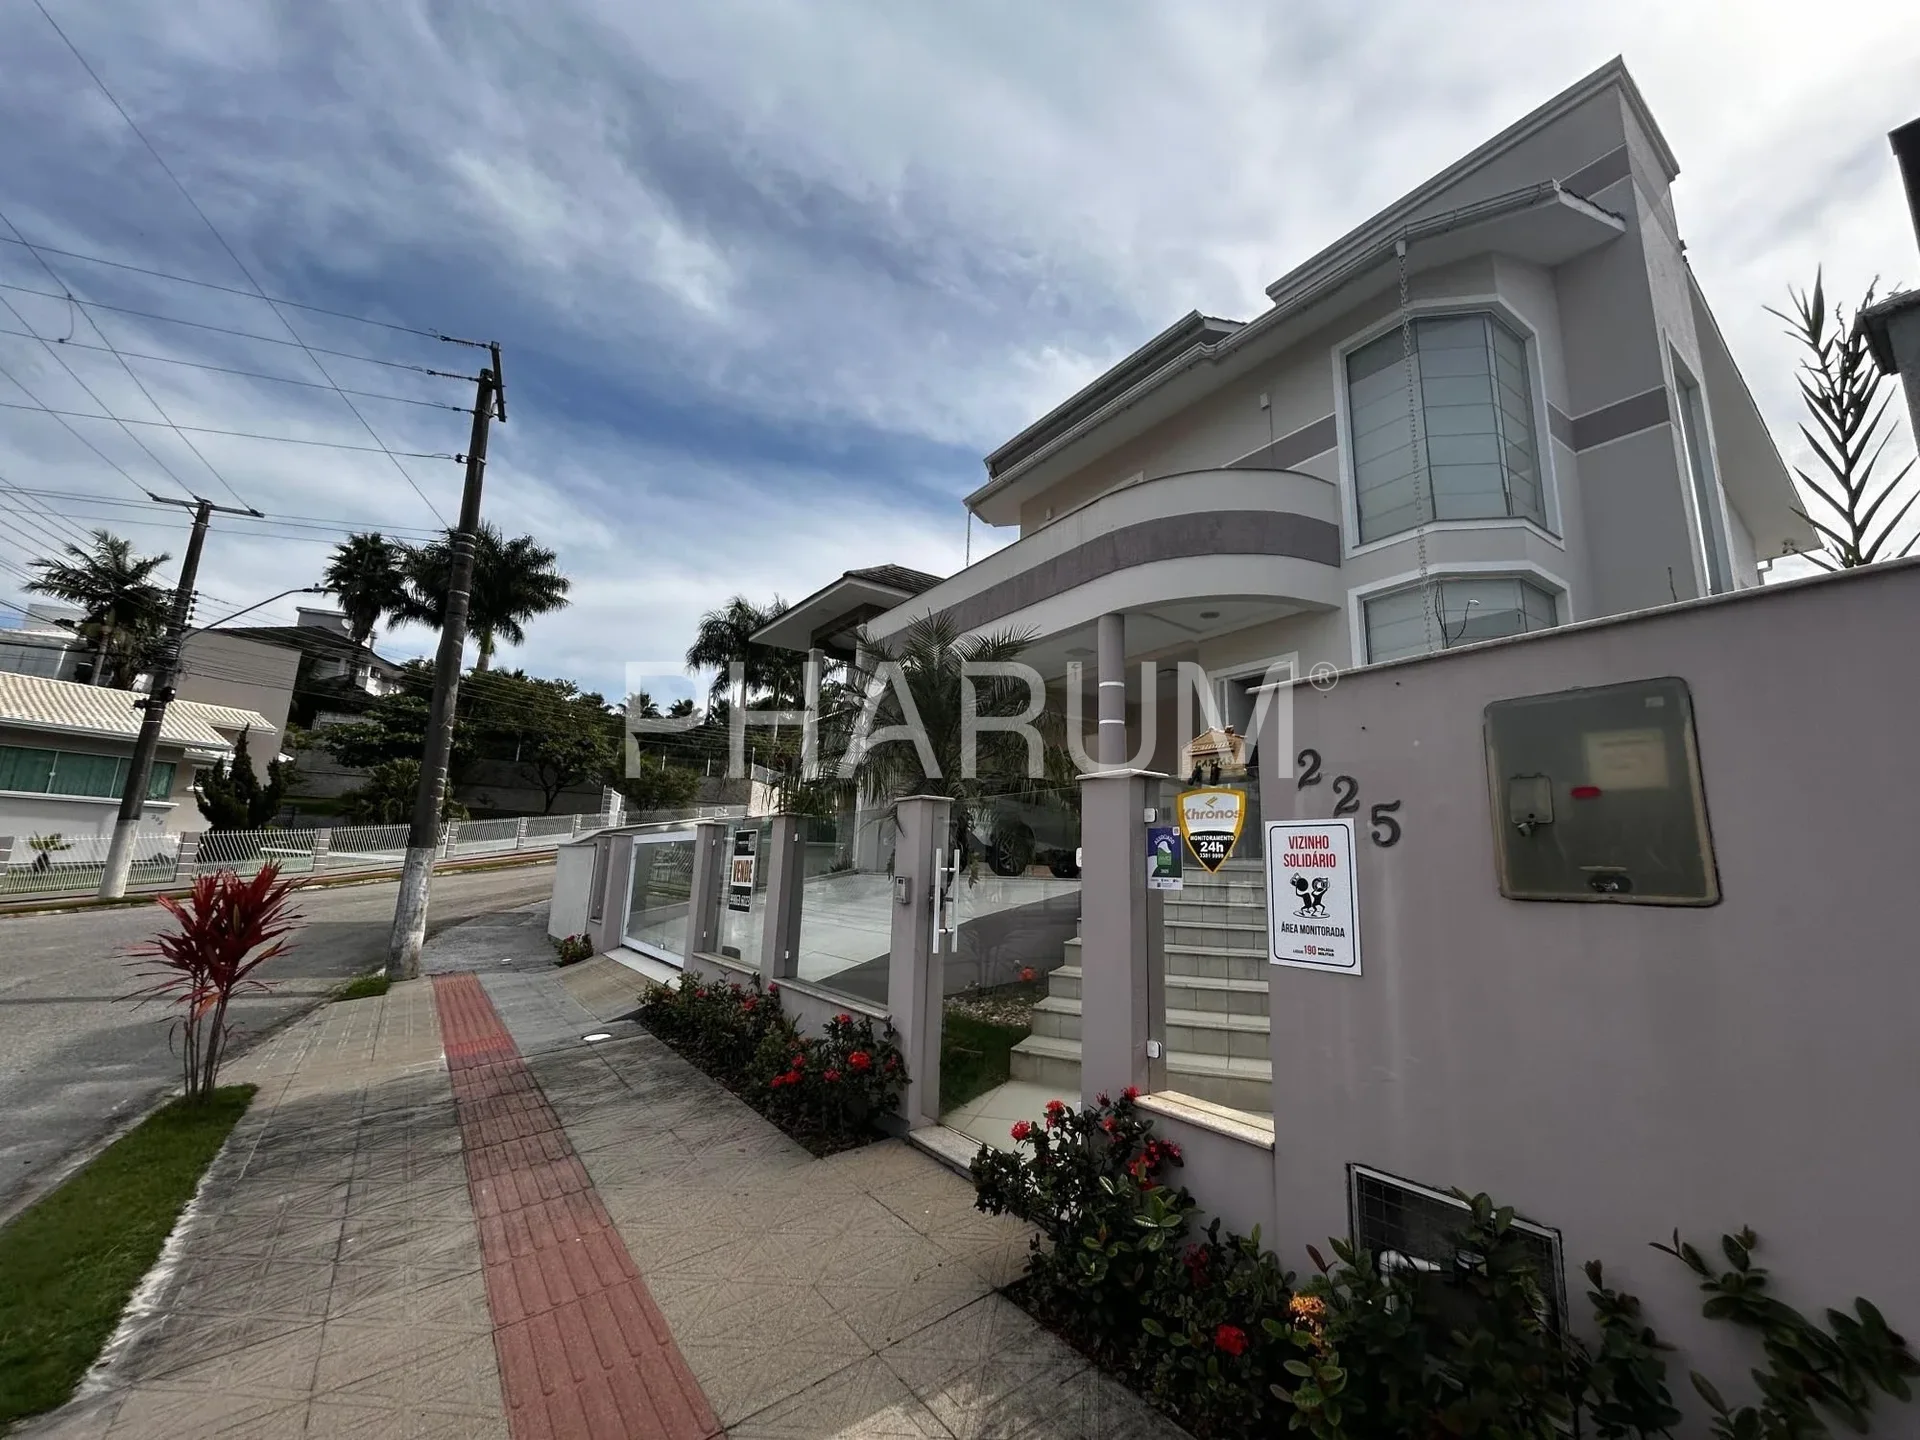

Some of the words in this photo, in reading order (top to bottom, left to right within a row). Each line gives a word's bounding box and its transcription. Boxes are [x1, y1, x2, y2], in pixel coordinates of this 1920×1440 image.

[1297, 748, 1401, 848] 225
[1183, 808, 1242, 820] Khronos
[1200, 841, 1224, 853] 24h
[1288, 835, 1329, 850] VIZINHO
[1283, 851, 1336, 868] SOLIDÁRIO
[1281, 922, 1298, 934] ÁREA
[1300, 924, 1345, 938] MONITORADA
[1304, 945, 1316, 955] 190
